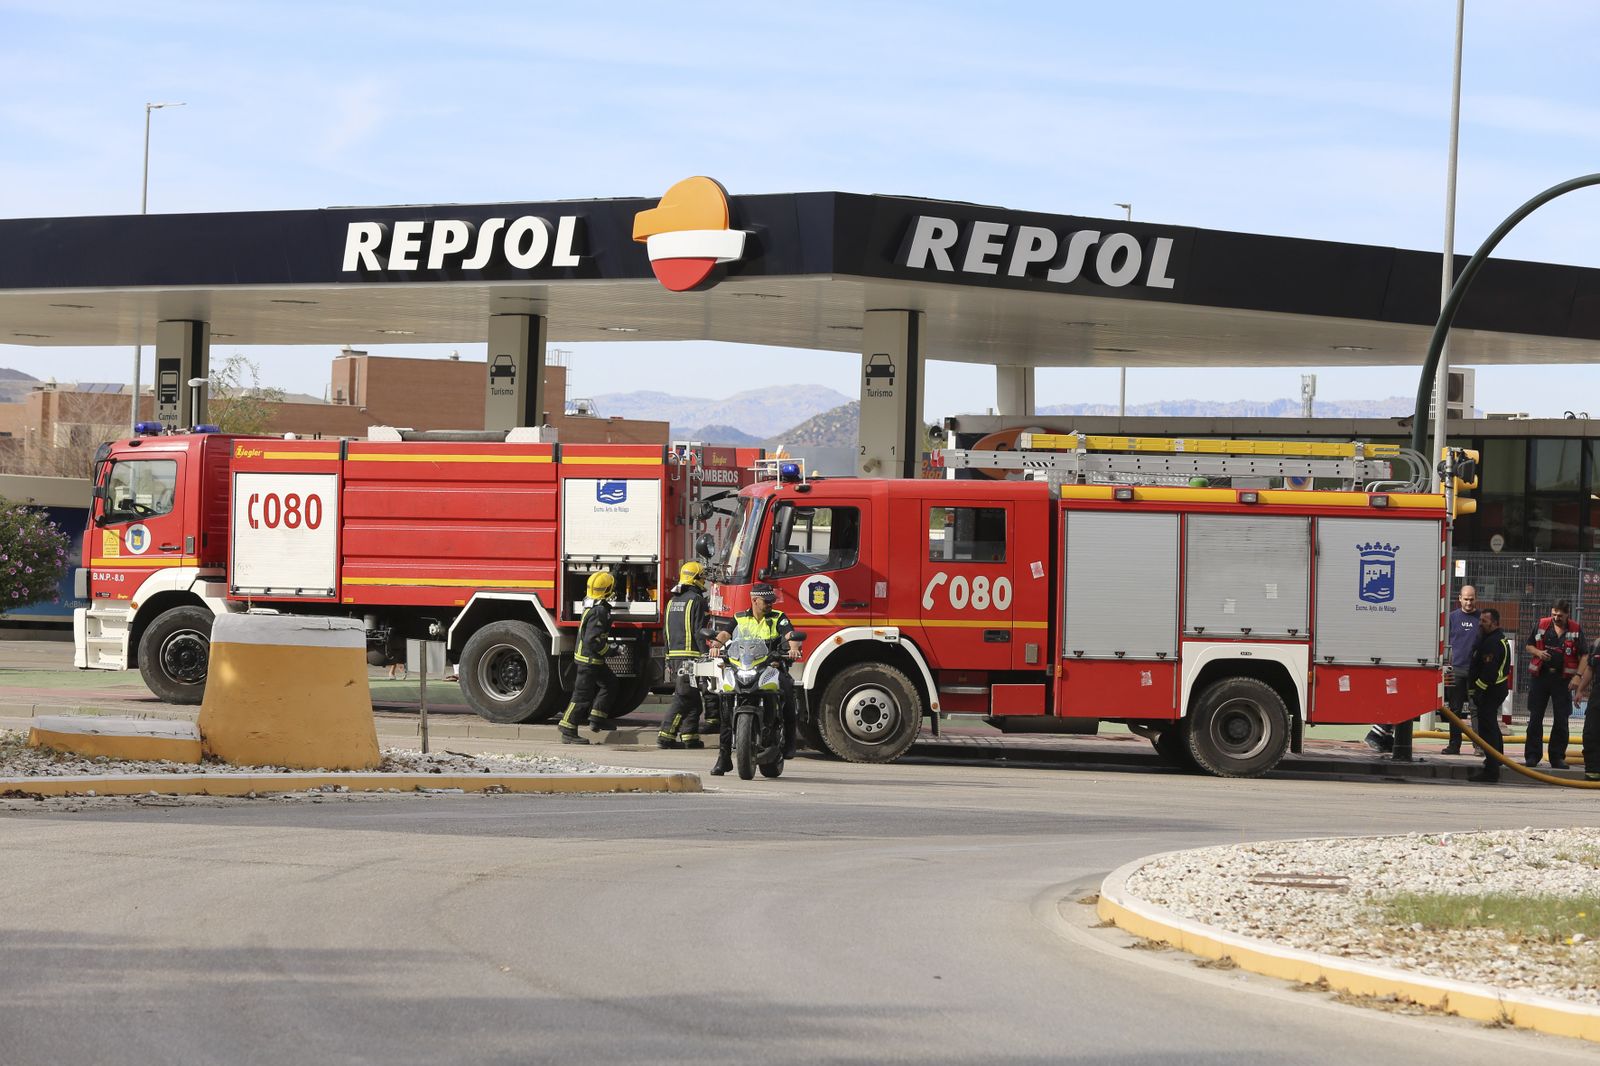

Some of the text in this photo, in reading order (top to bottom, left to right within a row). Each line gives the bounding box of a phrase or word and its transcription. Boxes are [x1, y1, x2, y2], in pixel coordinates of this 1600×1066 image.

[342, 215, 581, 272] REPSOL
[906, 215, 1175, 289] REPSOL
[490, 387, 514, 396] Turismo
[866, 388, 893, 398] Turismo
[860, 446, 866, 455] 2
[263, 493, 322, 530] 080
[949, 575, 1012, 611] 080
